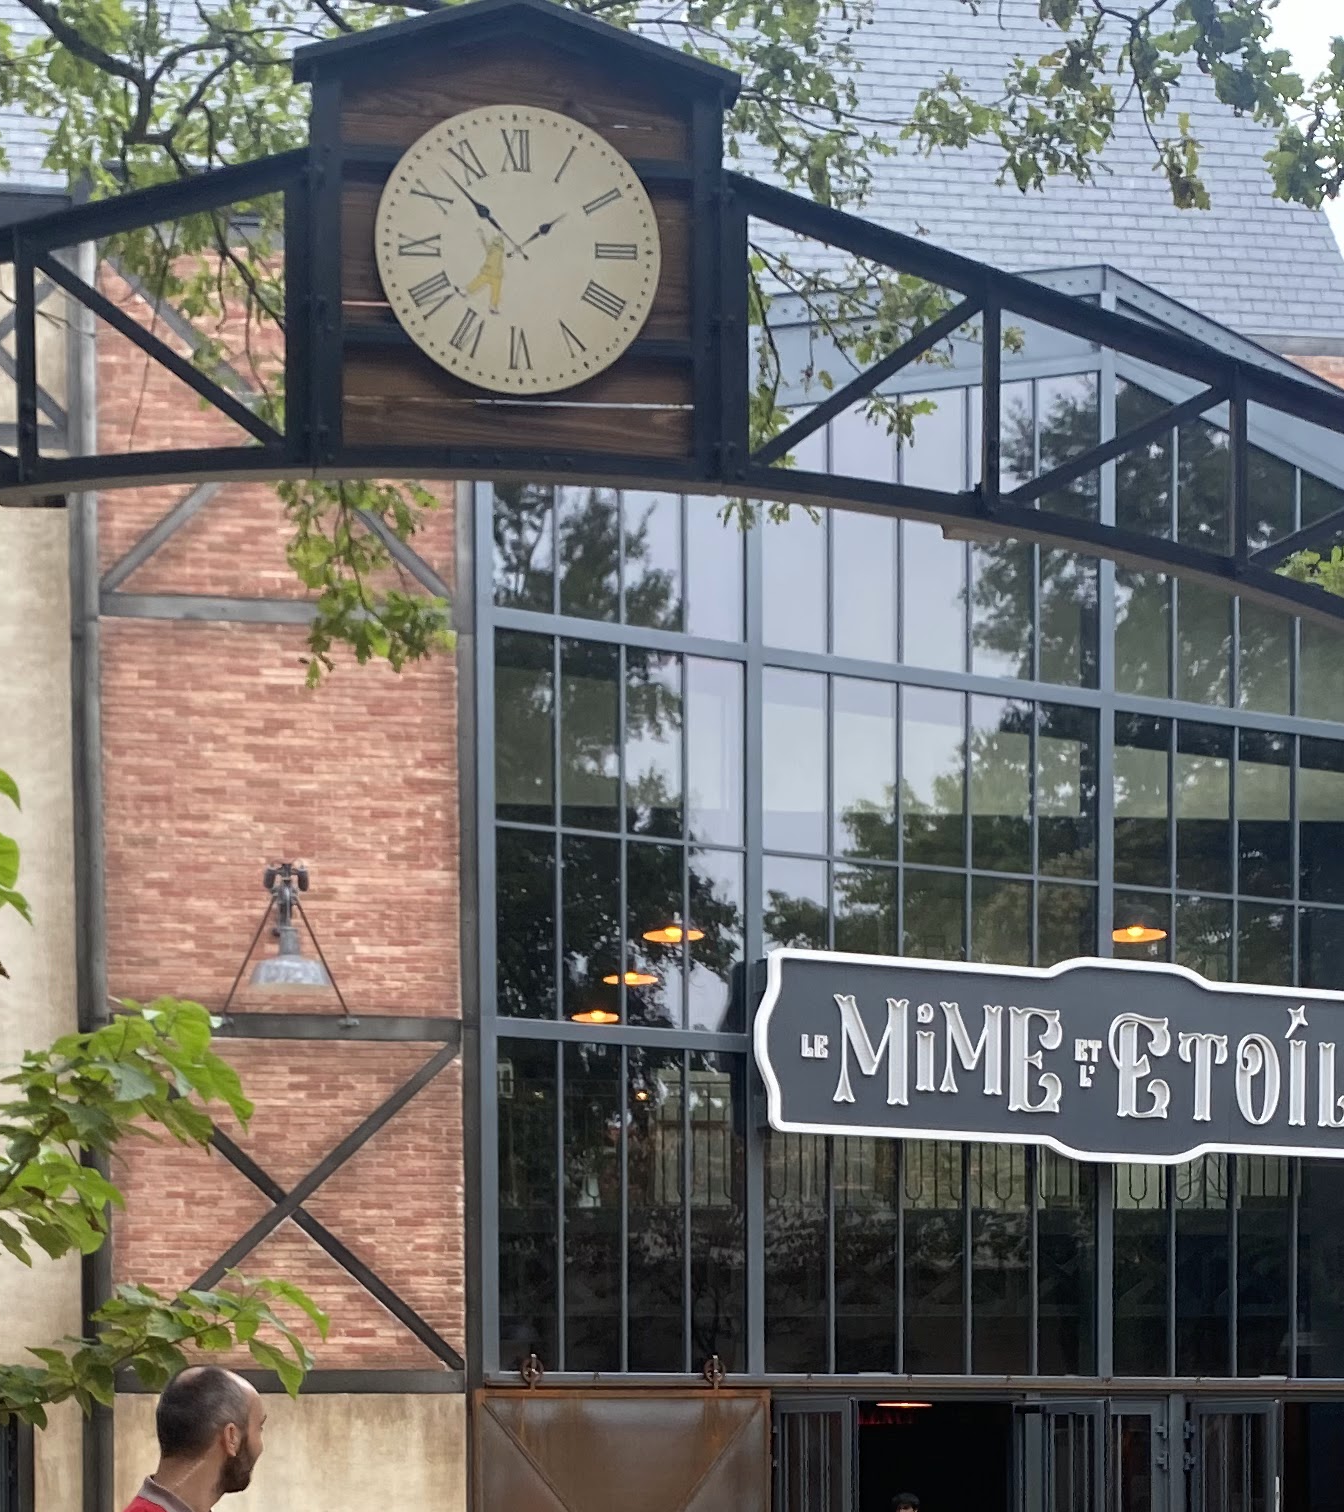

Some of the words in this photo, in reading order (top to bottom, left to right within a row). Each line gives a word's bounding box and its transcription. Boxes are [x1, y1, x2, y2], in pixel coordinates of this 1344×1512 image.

[801, 1033, 829, 1059] LE
[1074, 1038, 1103, 1063] ET
[1079, 1064, 1096, 1088] L'
